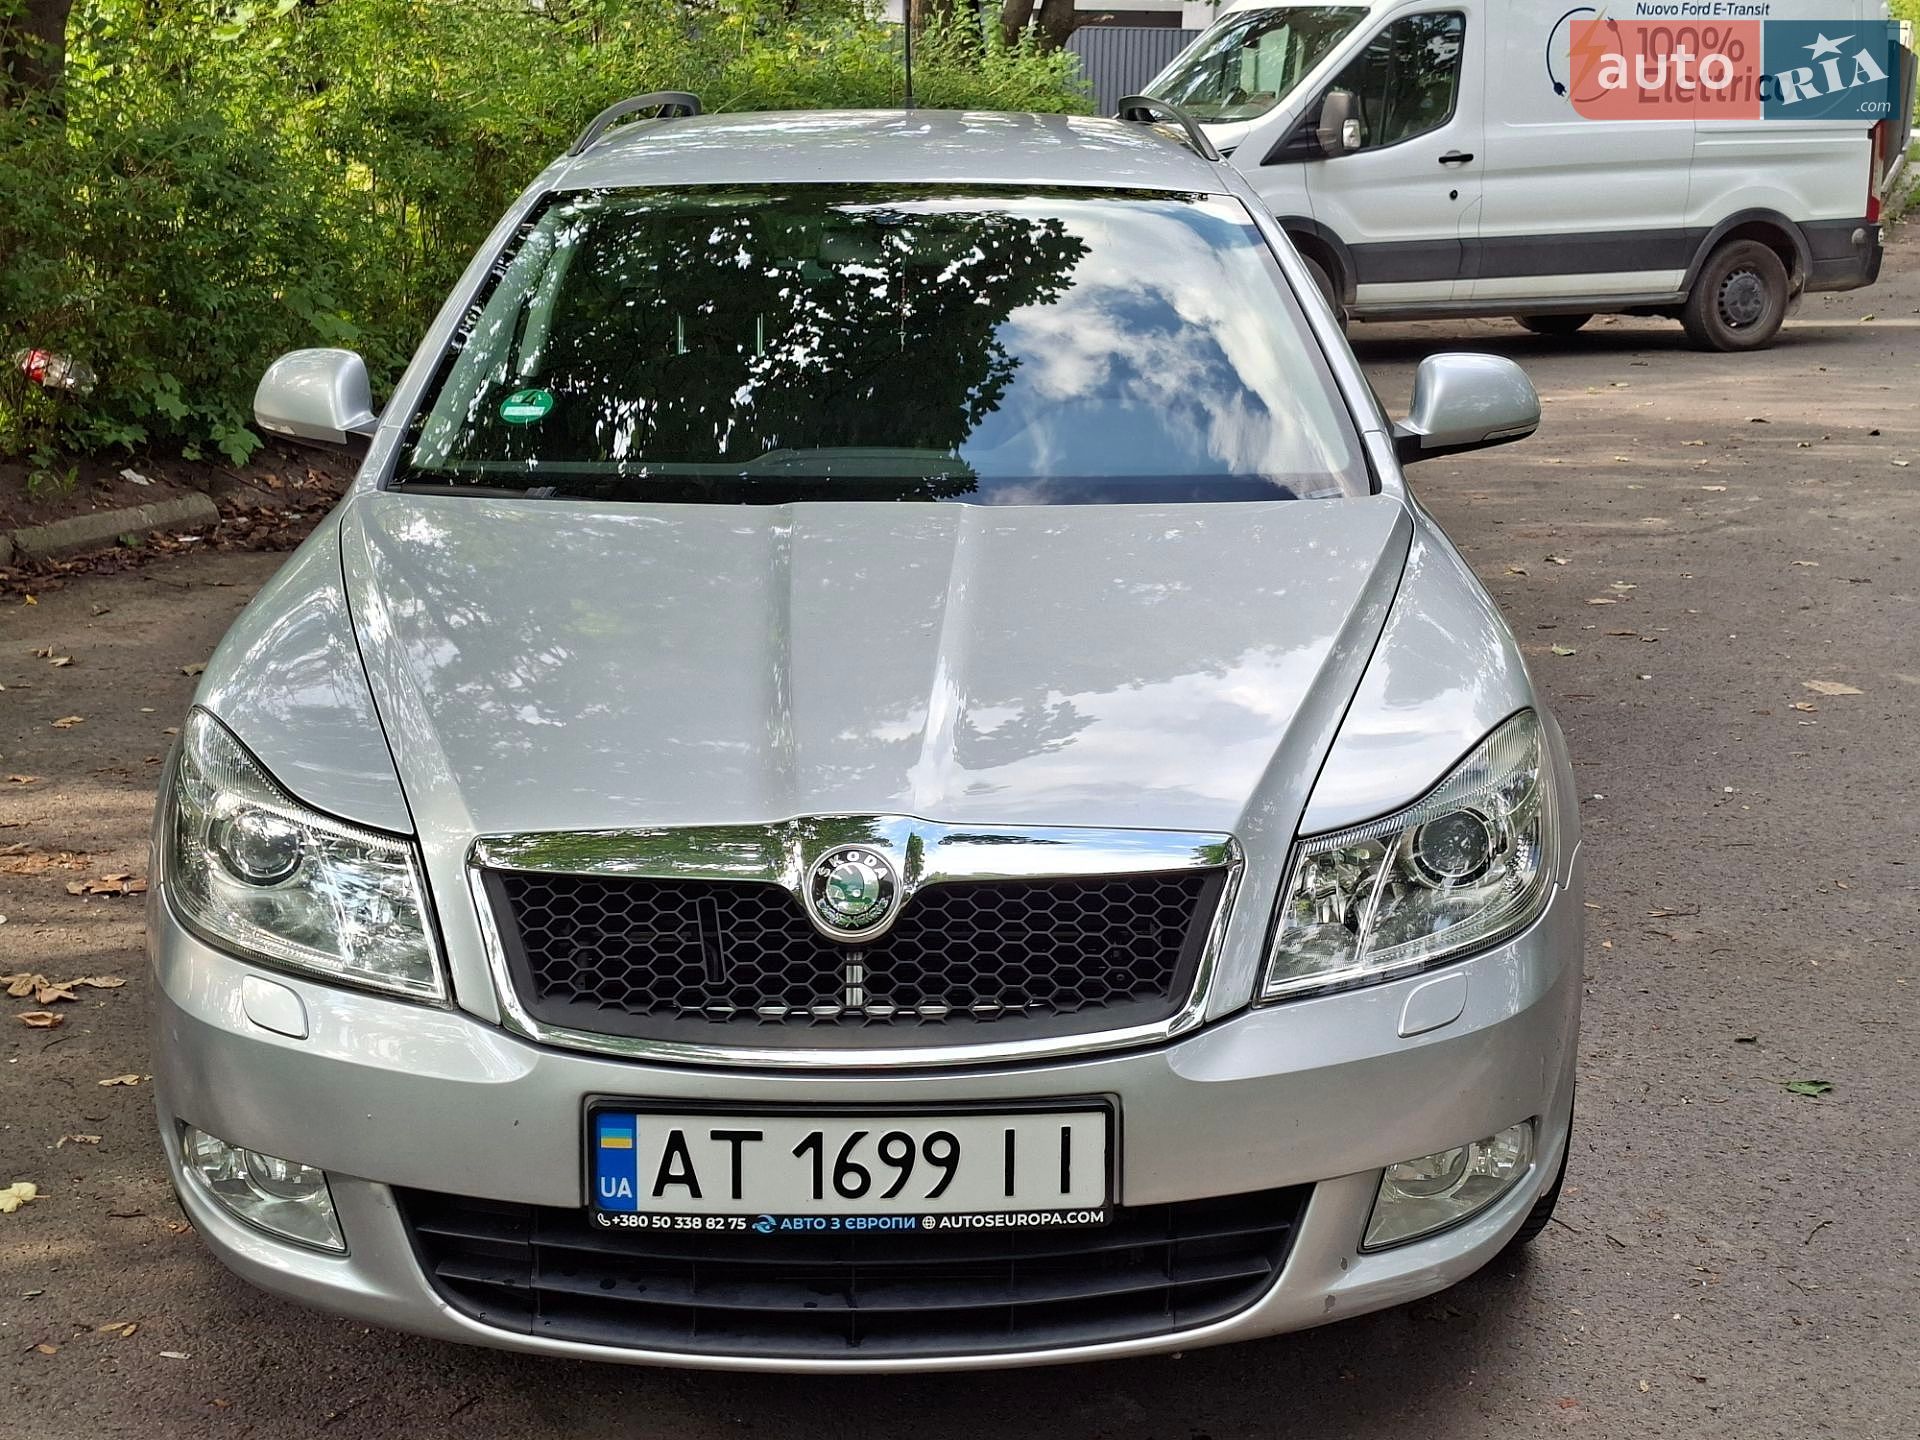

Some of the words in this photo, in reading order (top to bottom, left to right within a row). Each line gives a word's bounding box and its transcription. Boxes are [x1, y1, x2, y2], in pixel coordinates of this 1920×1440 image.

[1636, 2, 1679, 16] Nuovo
[1681, 2, 1711, 16] Ford
[1713, 2, 1770, 16] E-Transit
[1637, 26, 1745, 63] 100%
[652, 1129, 763, 1200] AT
[792, 1130, 961, 1200] 1699
[600, 1177, 633, 1198] UA
[612, 1214, 648, 1227] +380
[652, 1216, 671, 1228] 50
[674, 1217, 702, 1229] 338
[705, 1218, 725, 1230] 82
[728, 1218, 747, 1230] 75
[780, 1218, 826, 1230] АВТО
[845, 1217, 916, 1230] ЄВРОПИ
[939, 1211, 1104, 1229] AUTOSEUROPA.COM
